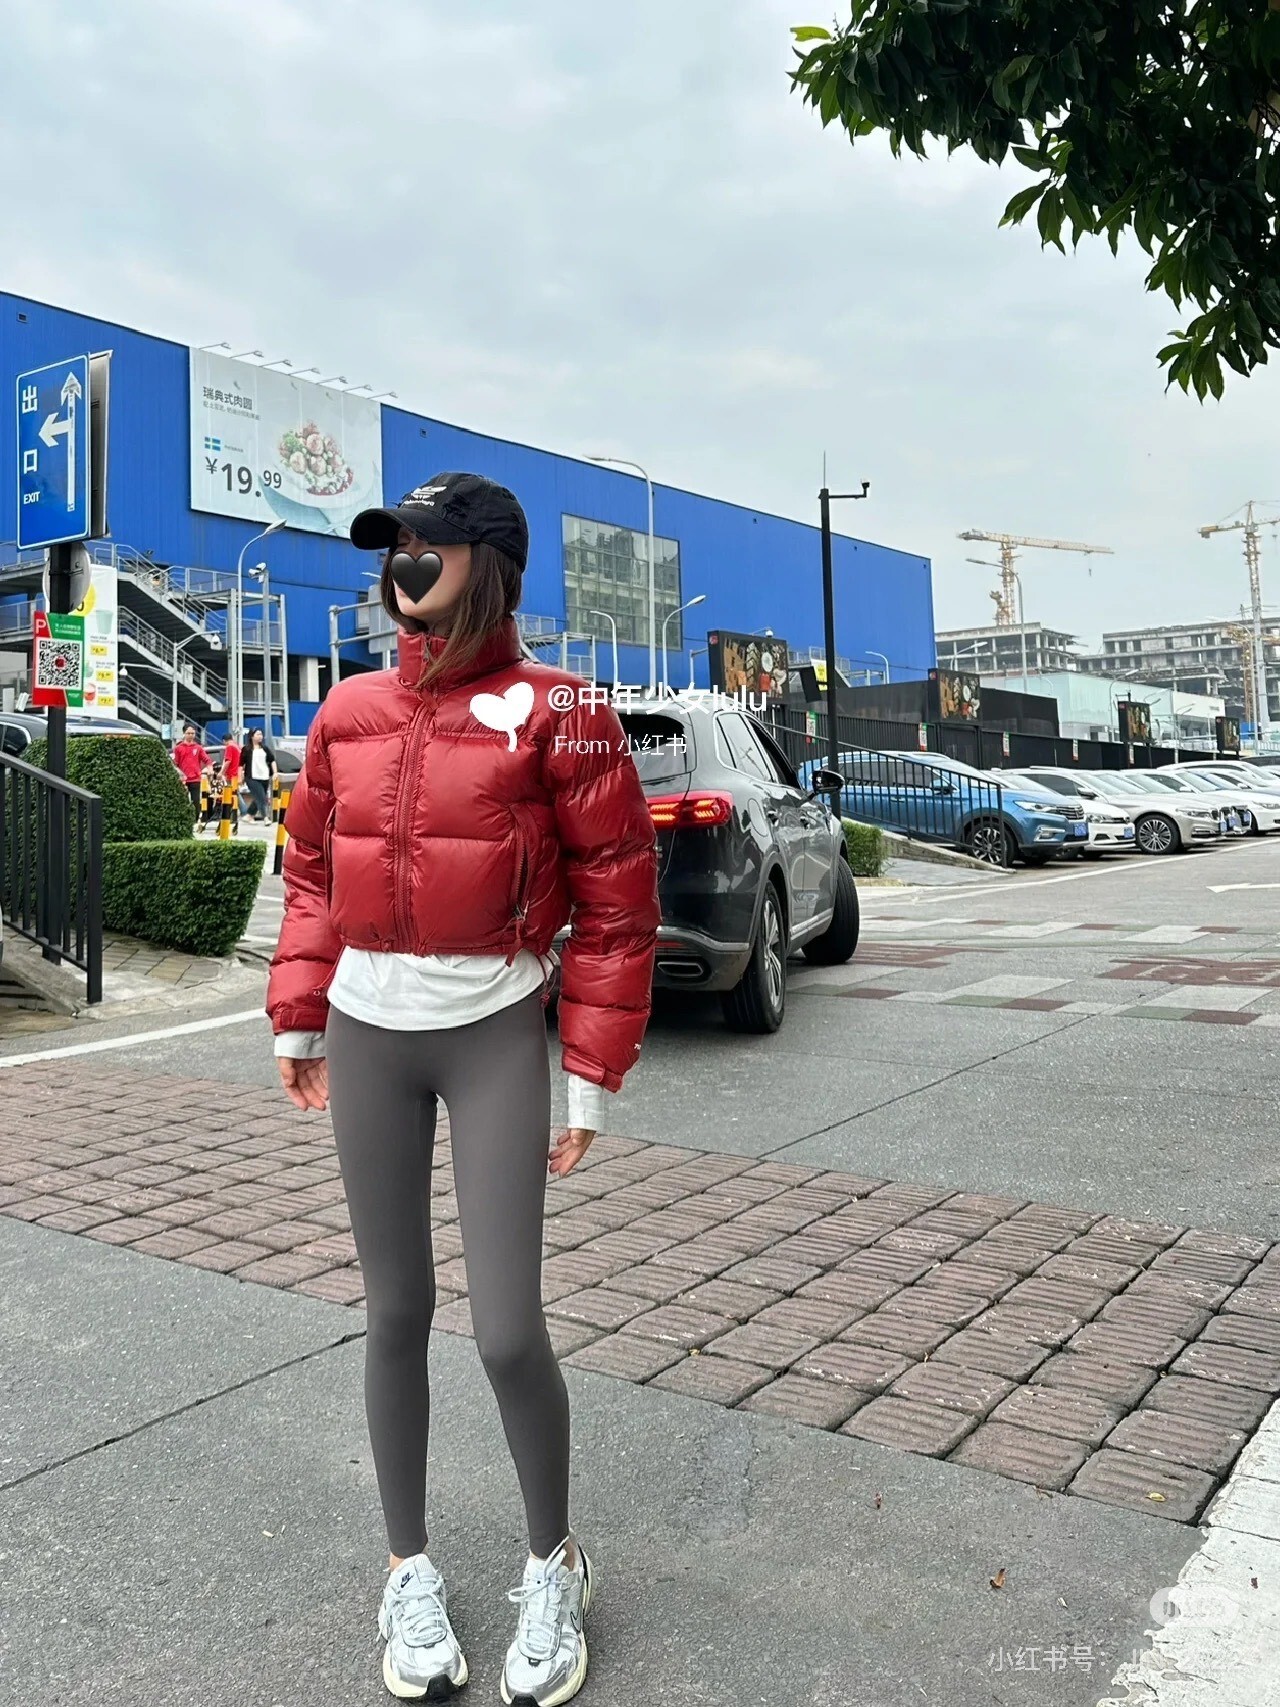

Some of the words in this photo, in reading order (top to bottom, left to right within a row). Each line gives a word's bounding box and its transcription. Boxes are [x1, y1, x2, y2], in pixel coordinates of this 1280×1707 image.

[22, 385, 37, 474] 出口
[23, 491, 40, 504] EXIT
[35, 619, 47, 634] P
